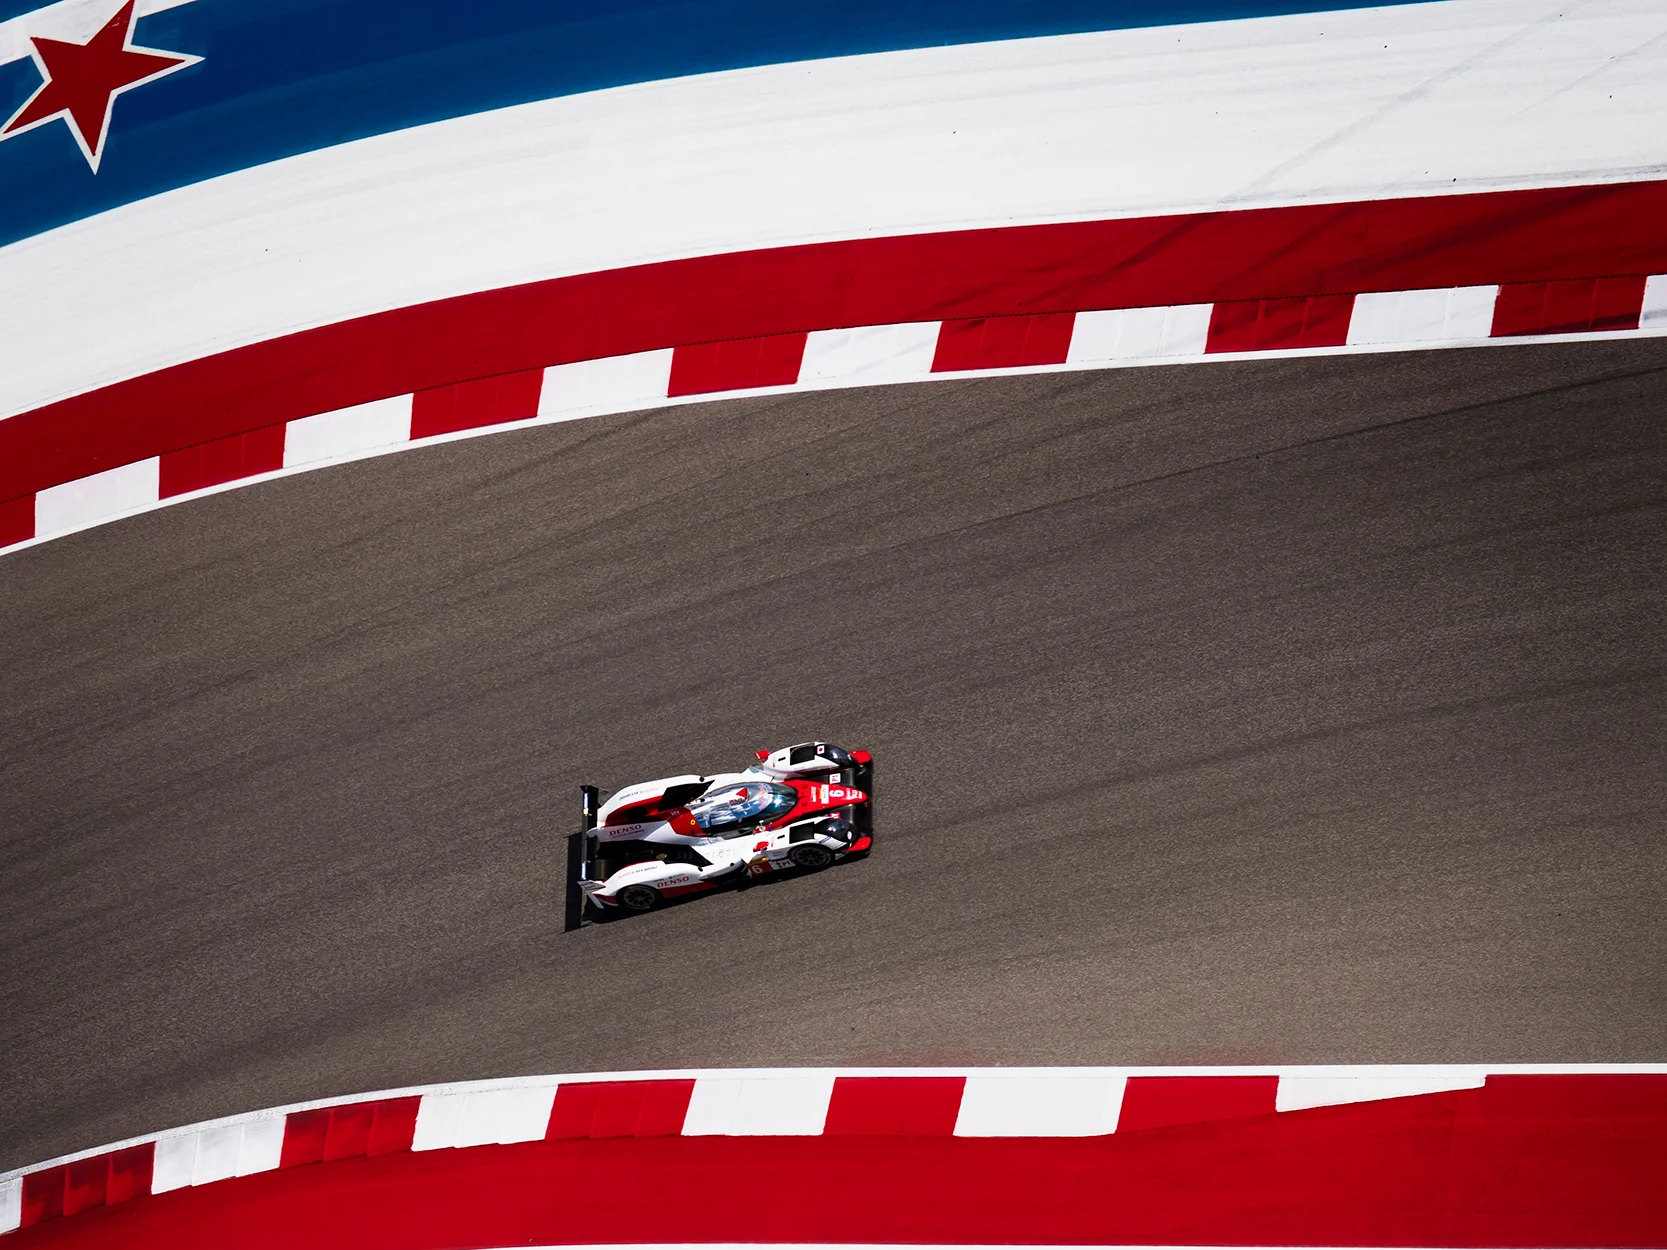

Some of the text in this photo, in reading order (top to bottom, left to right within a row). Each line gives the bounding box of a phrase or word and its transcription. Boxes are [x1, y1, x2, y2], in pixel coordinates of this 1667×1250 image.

[610, 825, 641, 836] DENSO
[752, 865, 763, 873] 6
[657, 877, 689, 888] DENSO
